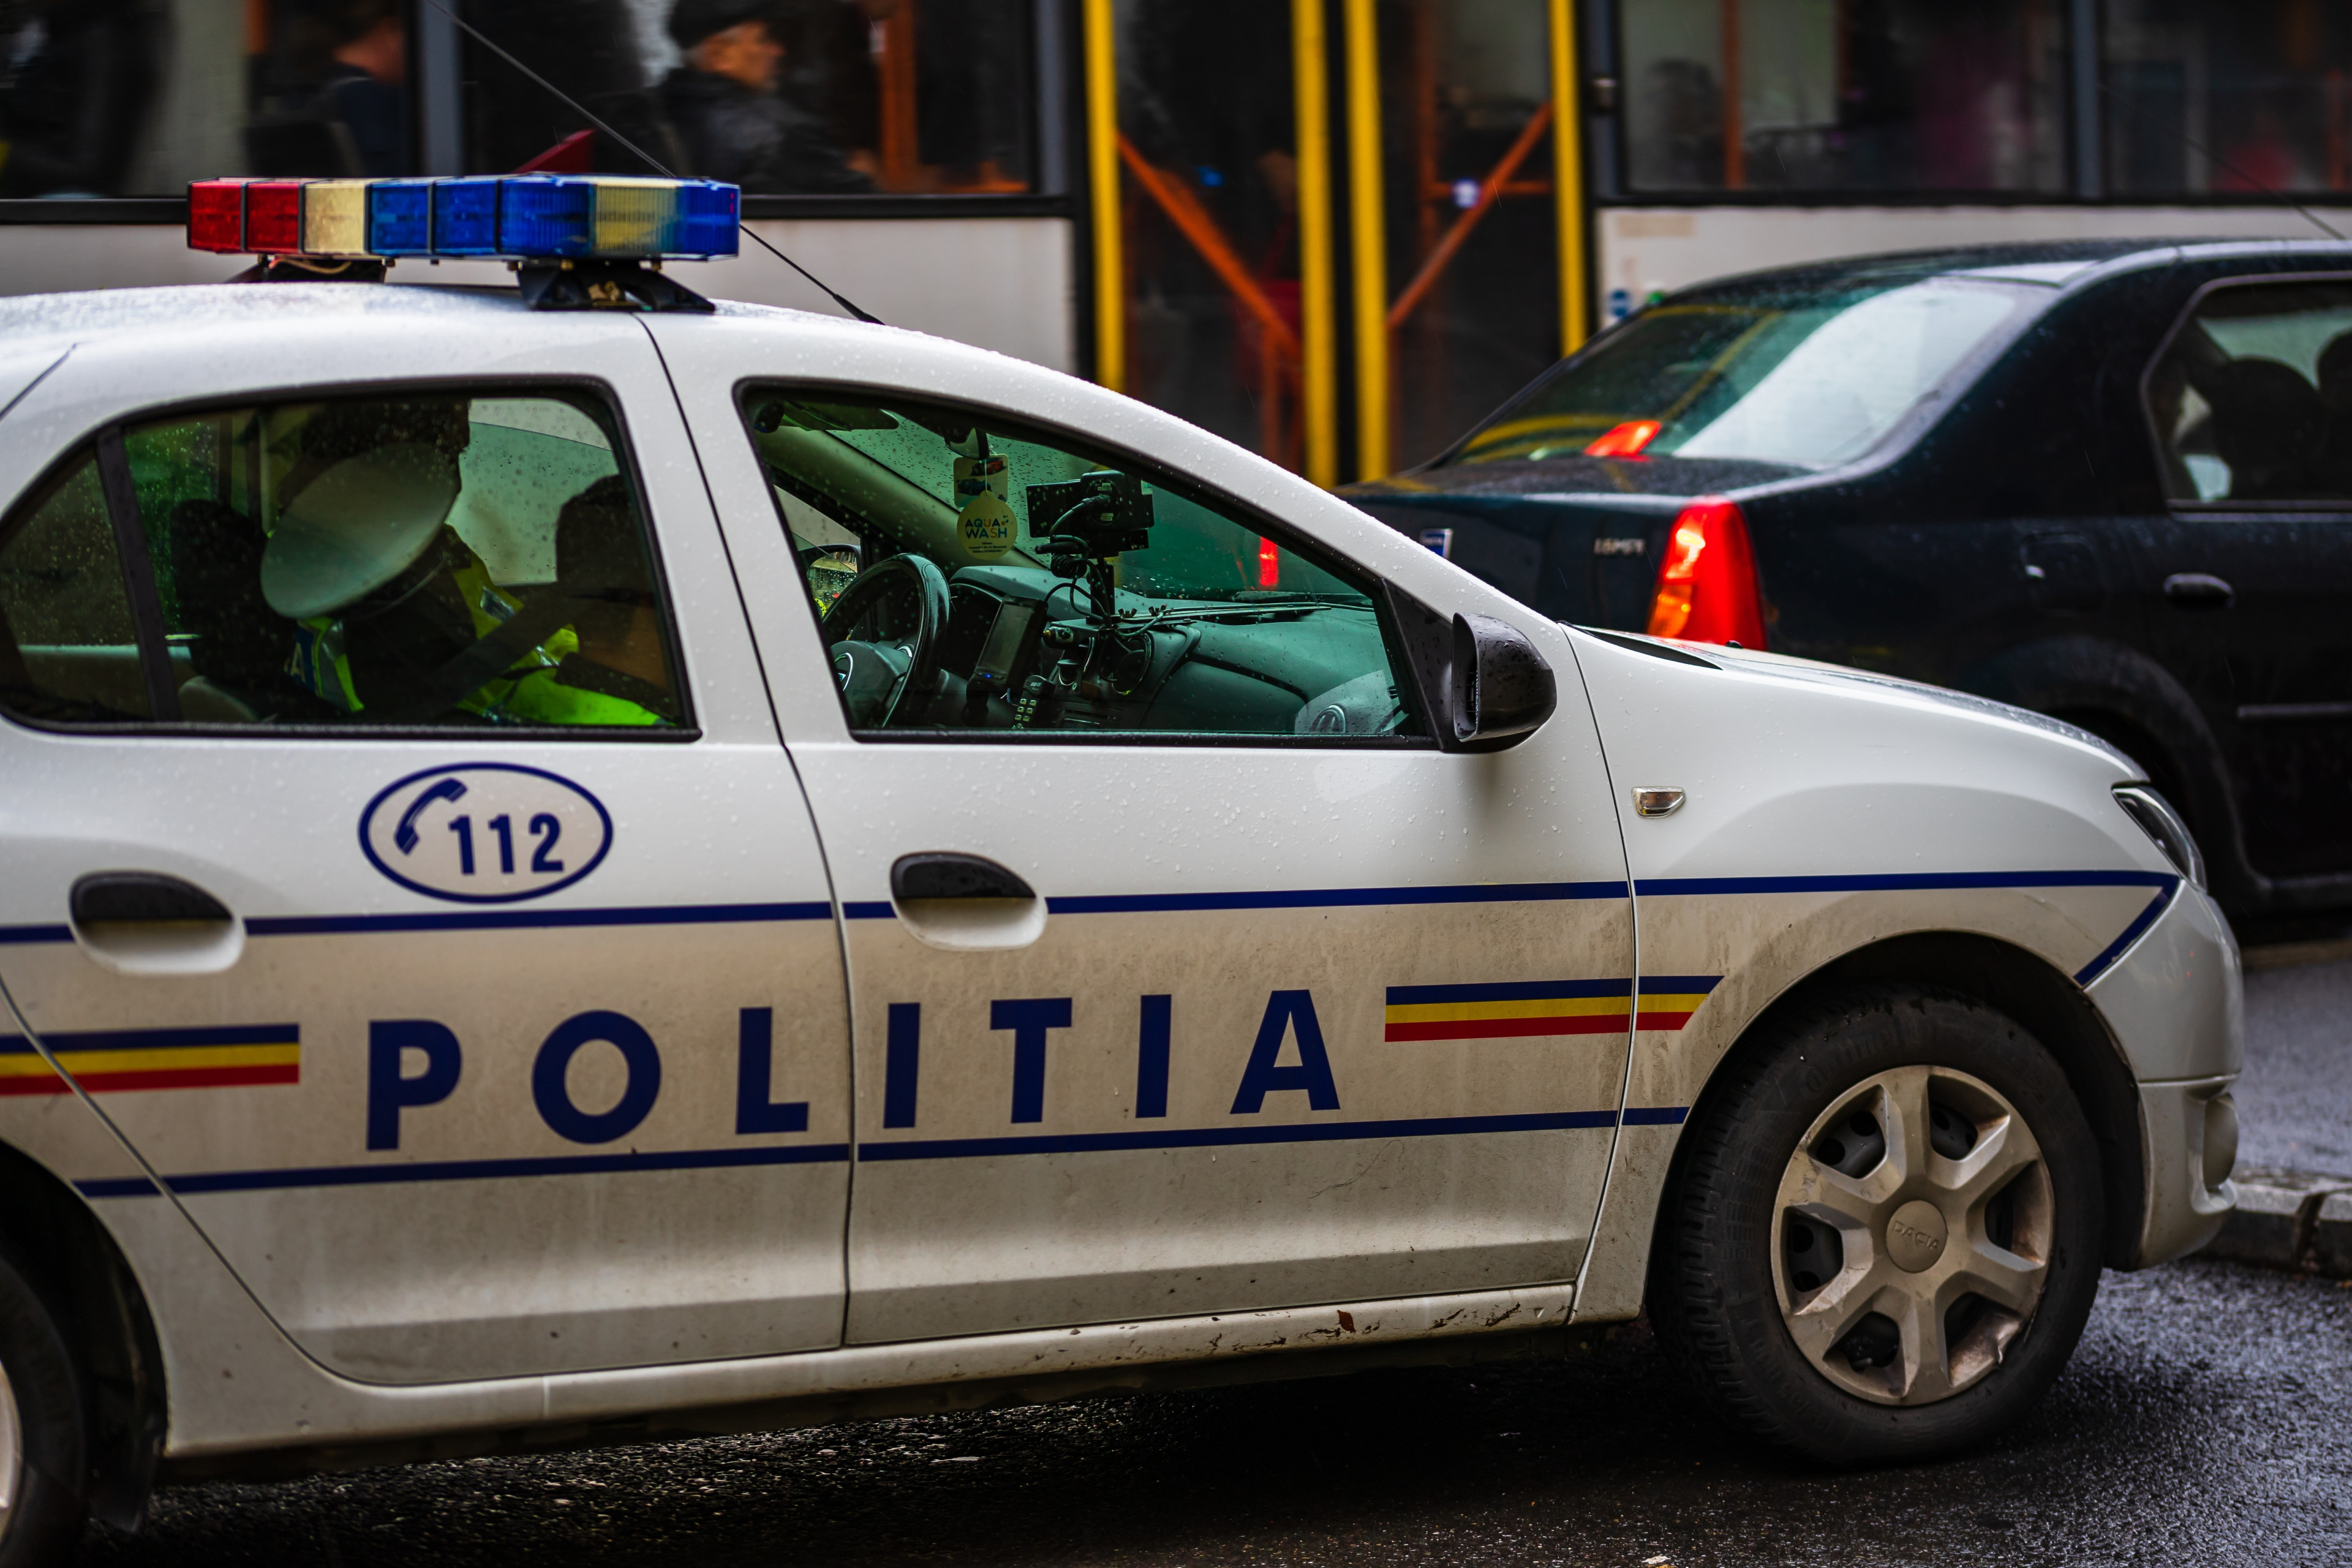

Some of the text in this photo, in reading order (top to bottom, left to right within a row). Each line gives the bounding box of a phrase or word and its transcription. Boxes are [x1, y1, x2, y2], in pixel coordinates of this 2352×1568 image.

[965, 518, 1000, 527] AQUA
[965, 527, 1007, 539] WASH
[448, 812, 564, 875] 112
[366, 989, 1340, 1151] POLITIA
[1892, 1220, 1939, 1250] DACIA
